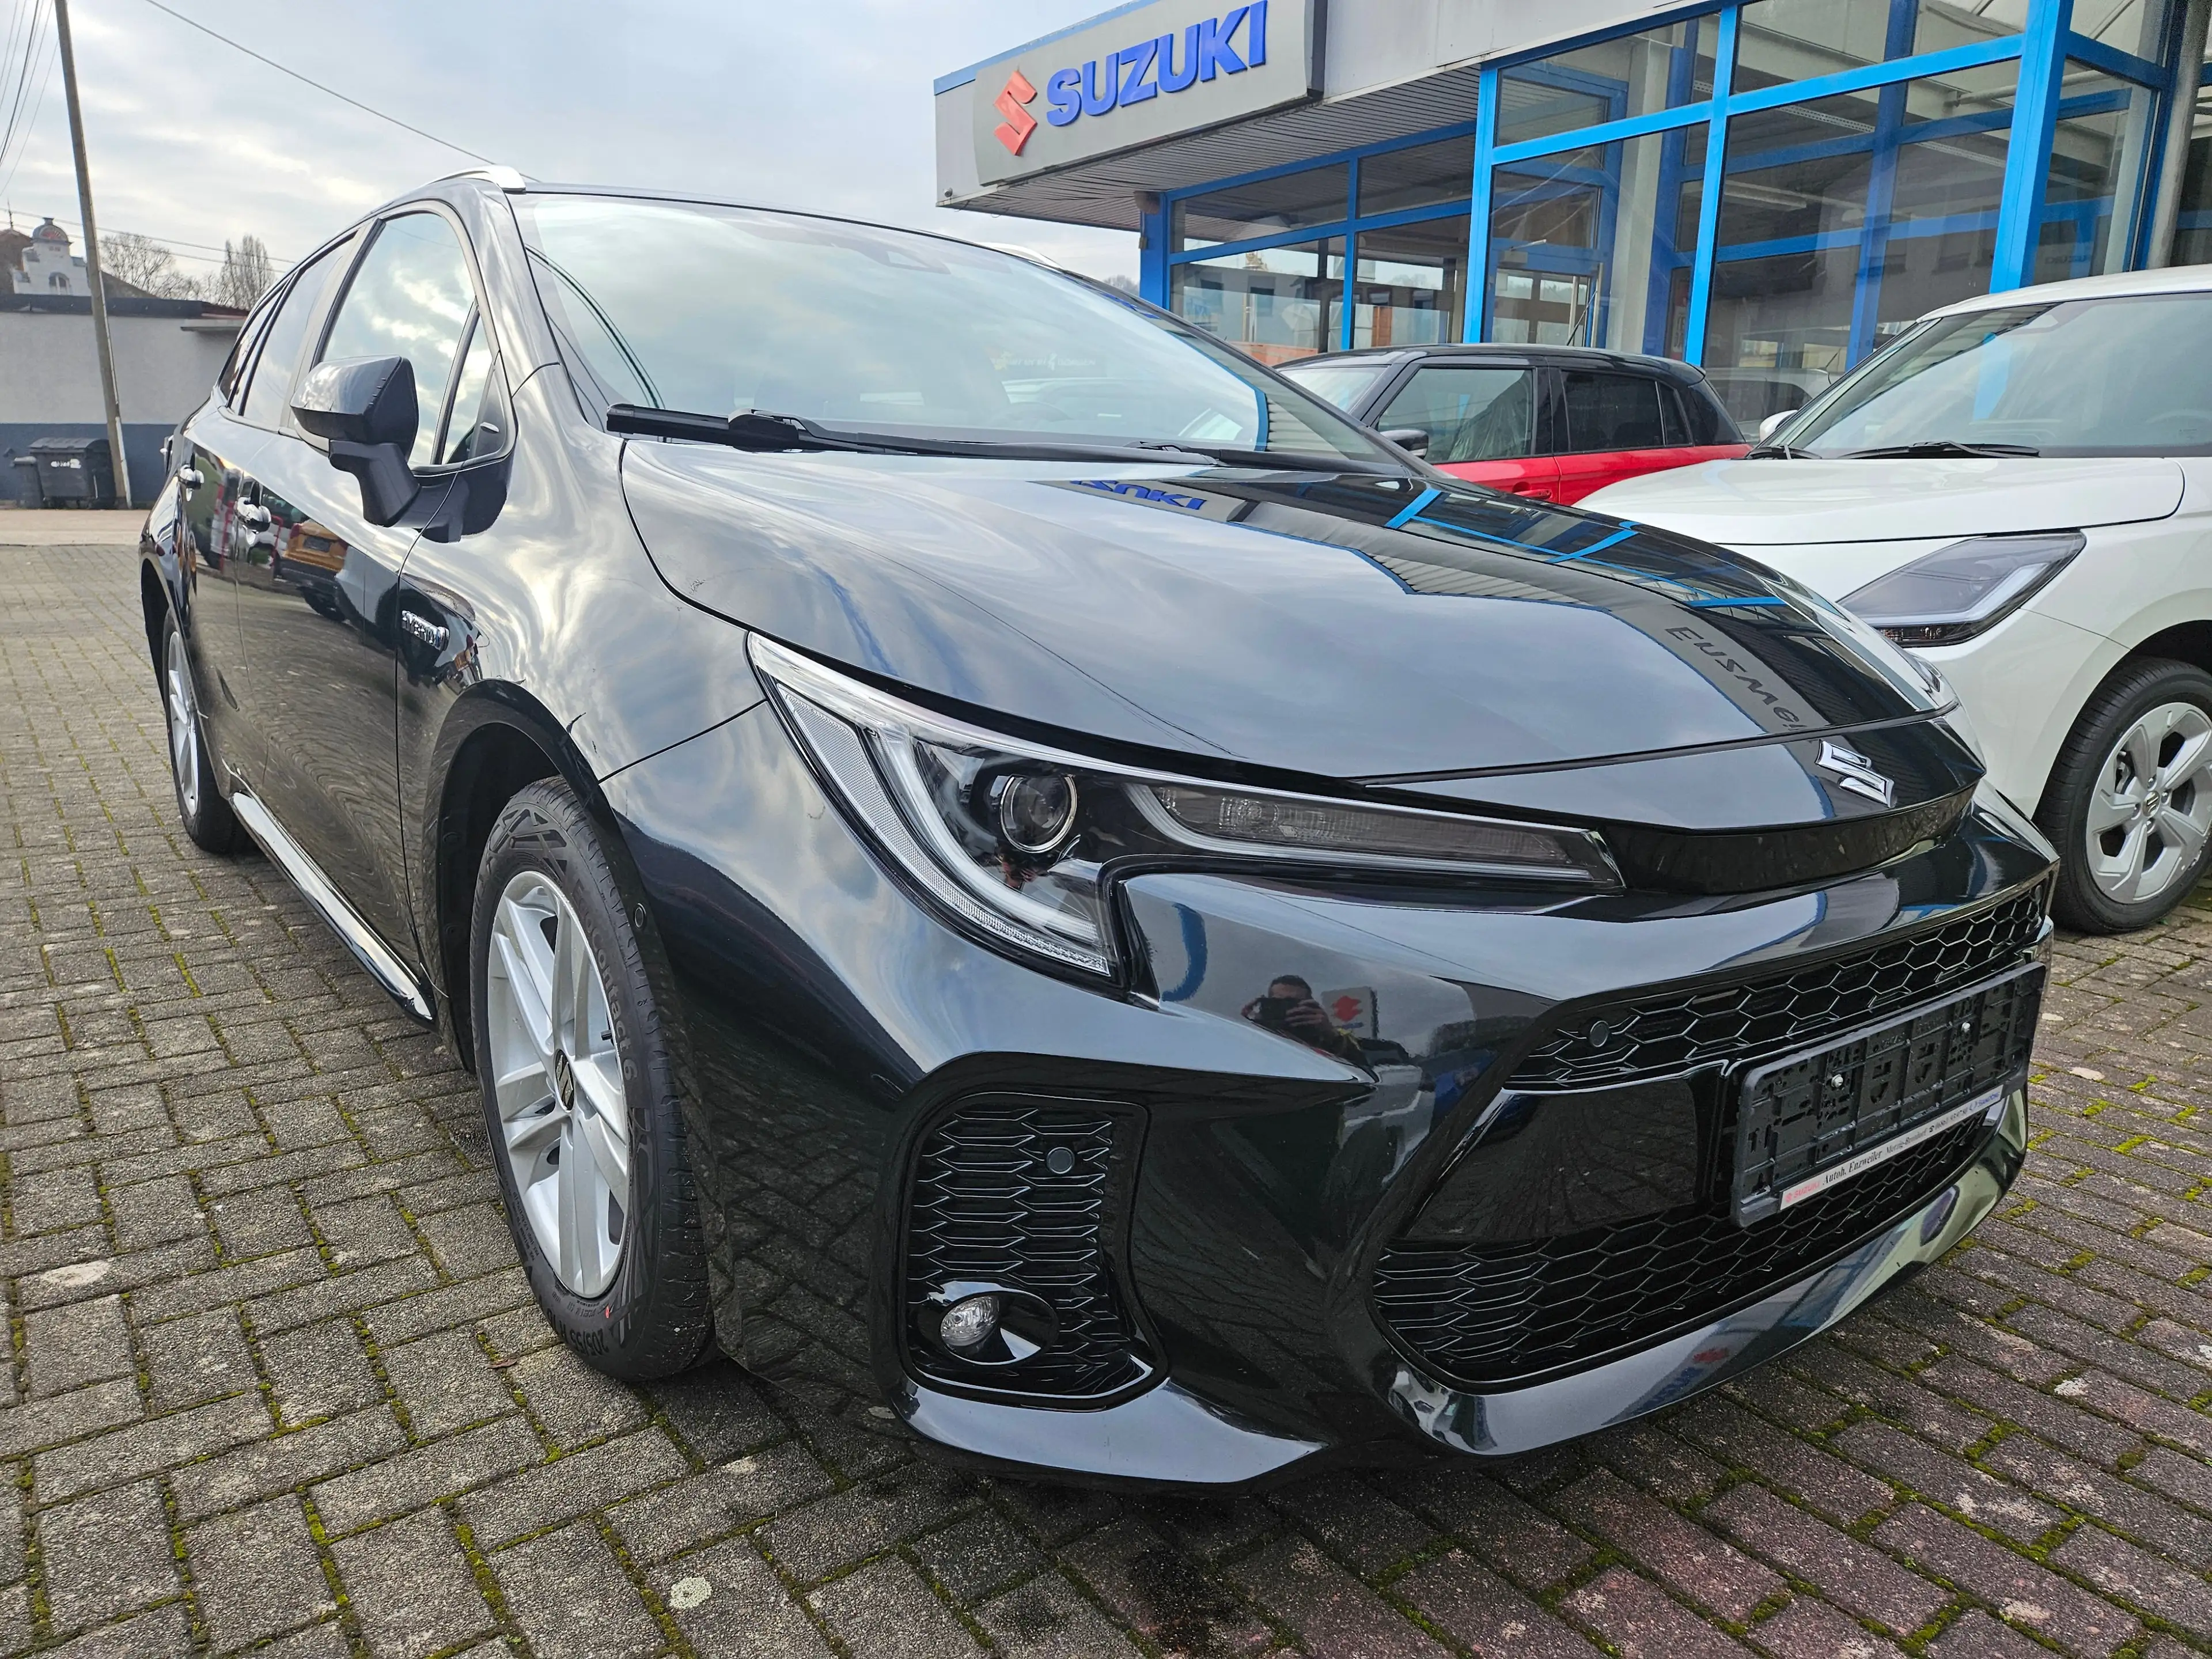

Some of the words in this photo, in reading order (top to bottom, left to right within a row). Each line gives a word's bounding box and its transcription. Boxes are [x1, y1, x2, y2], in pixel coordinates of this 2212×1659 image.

[1046, 0, 1267, 127] SUZUKI
[623, 1059, 638, 1081] 6
[1823, 1167, 1847, 1185] Autoh.
[1849, 1150, 1883, 1173] Enzweiler
